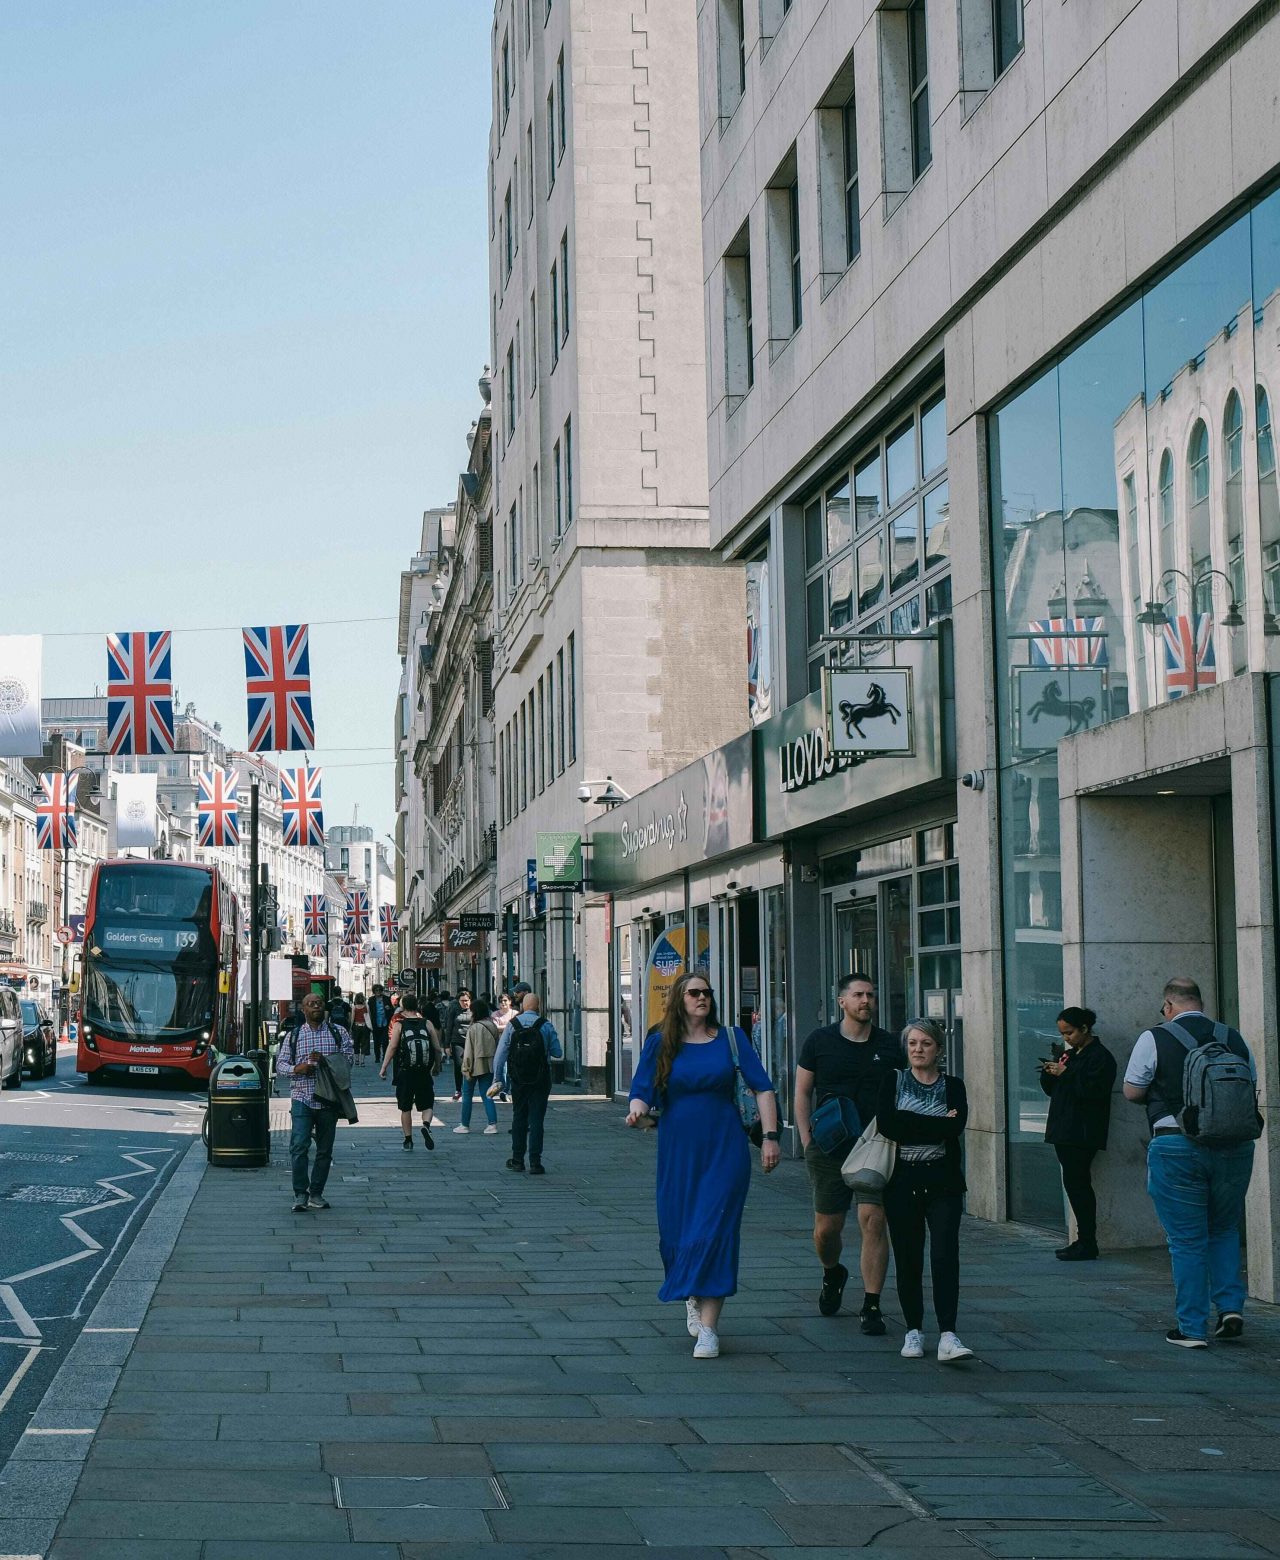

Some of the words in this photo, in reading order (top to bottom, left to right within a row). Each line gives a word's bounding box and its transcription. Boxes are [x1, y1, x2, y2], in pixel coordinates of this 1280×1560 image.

[621, 810, 675, 863] Superdrug
[106, 931, 137, 942] Golders
[139, 933, 163, 944] Green
[176, 930, 198, 948] 139
[449, 928, 478, 940] Pizza
[453, 937, 475, 947] Hut
[661, 968, 677, 977] SIM
[129, 1044, 163, 1054] Metroline
